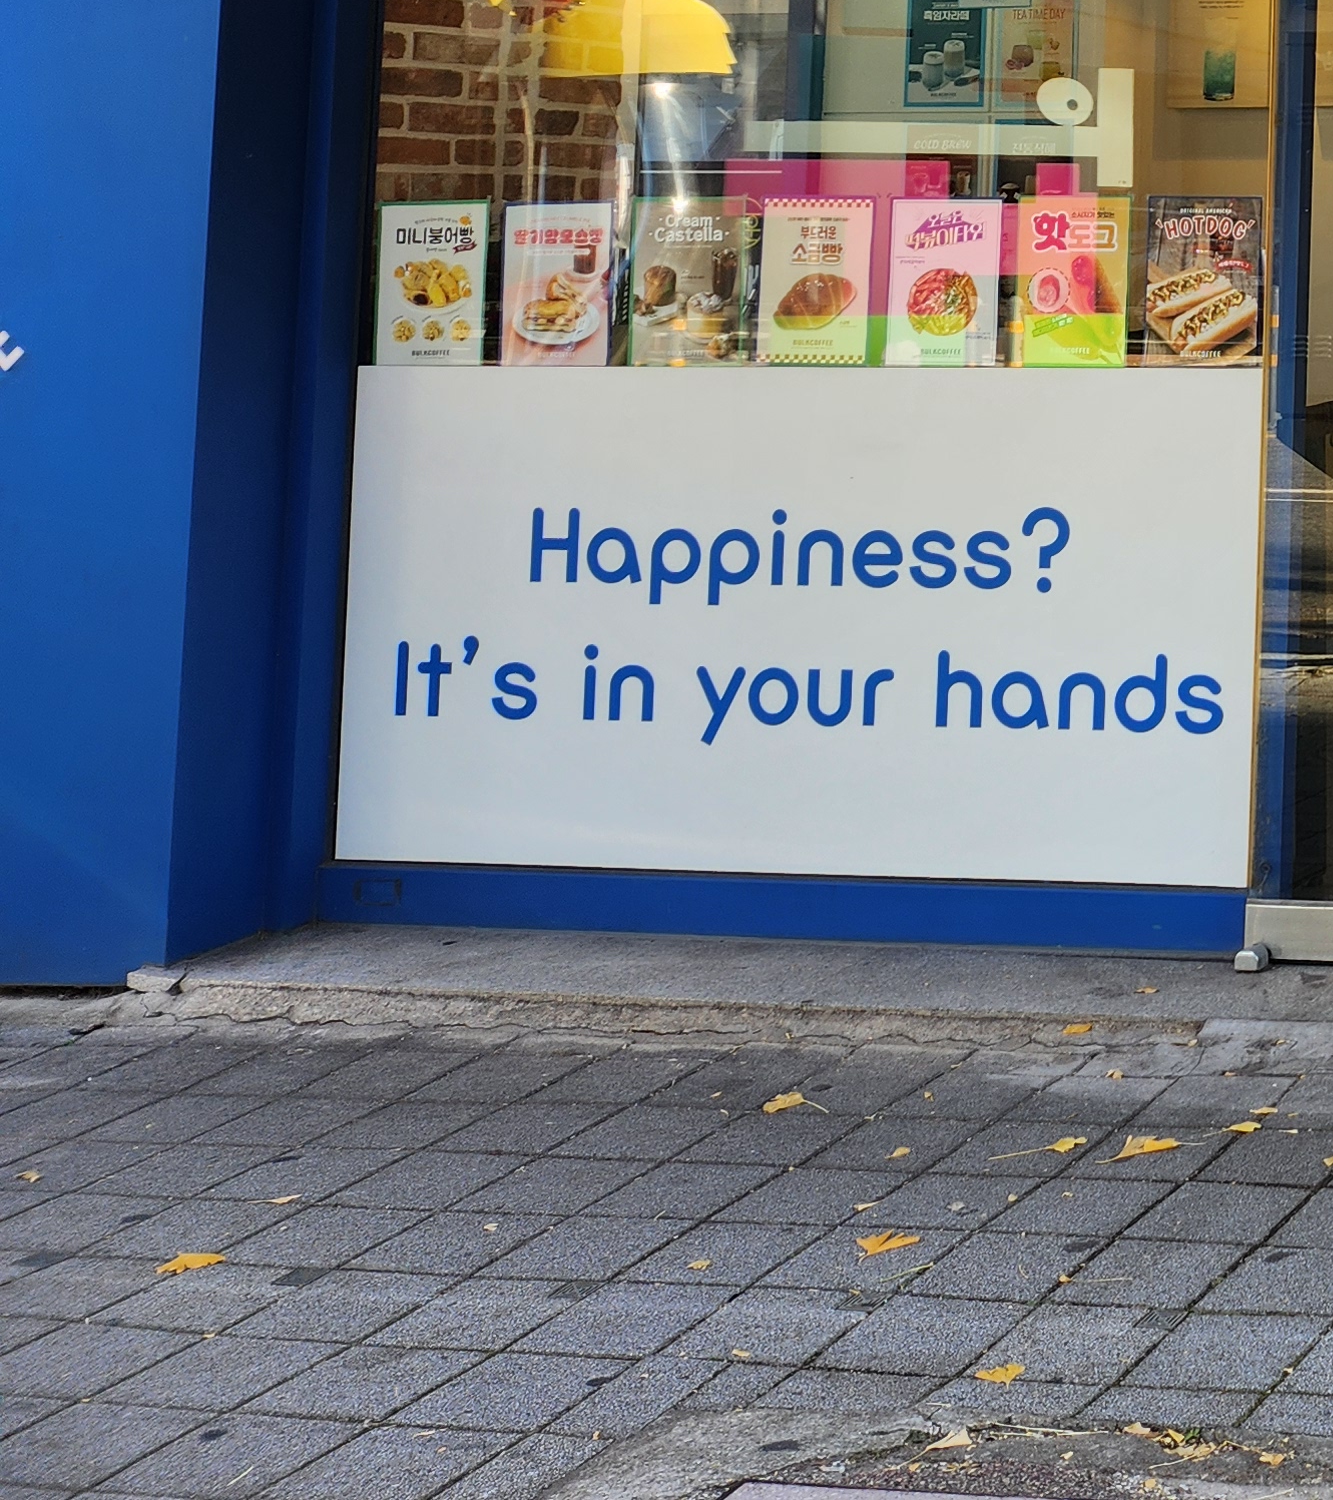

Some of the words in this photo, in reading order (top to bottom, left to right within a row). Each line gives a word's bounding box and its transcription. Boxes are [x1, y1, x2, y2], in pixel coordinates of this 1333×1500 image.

[396, 227, 475, 246] 미니붕어빵
[529, 506, 1071, 606] Happiness?
[395, 635, 538, 721] It's
[582, 643, 655, 722] in
[697, 665, 895, 746] your
[934, 649, 1225, 735] hands
